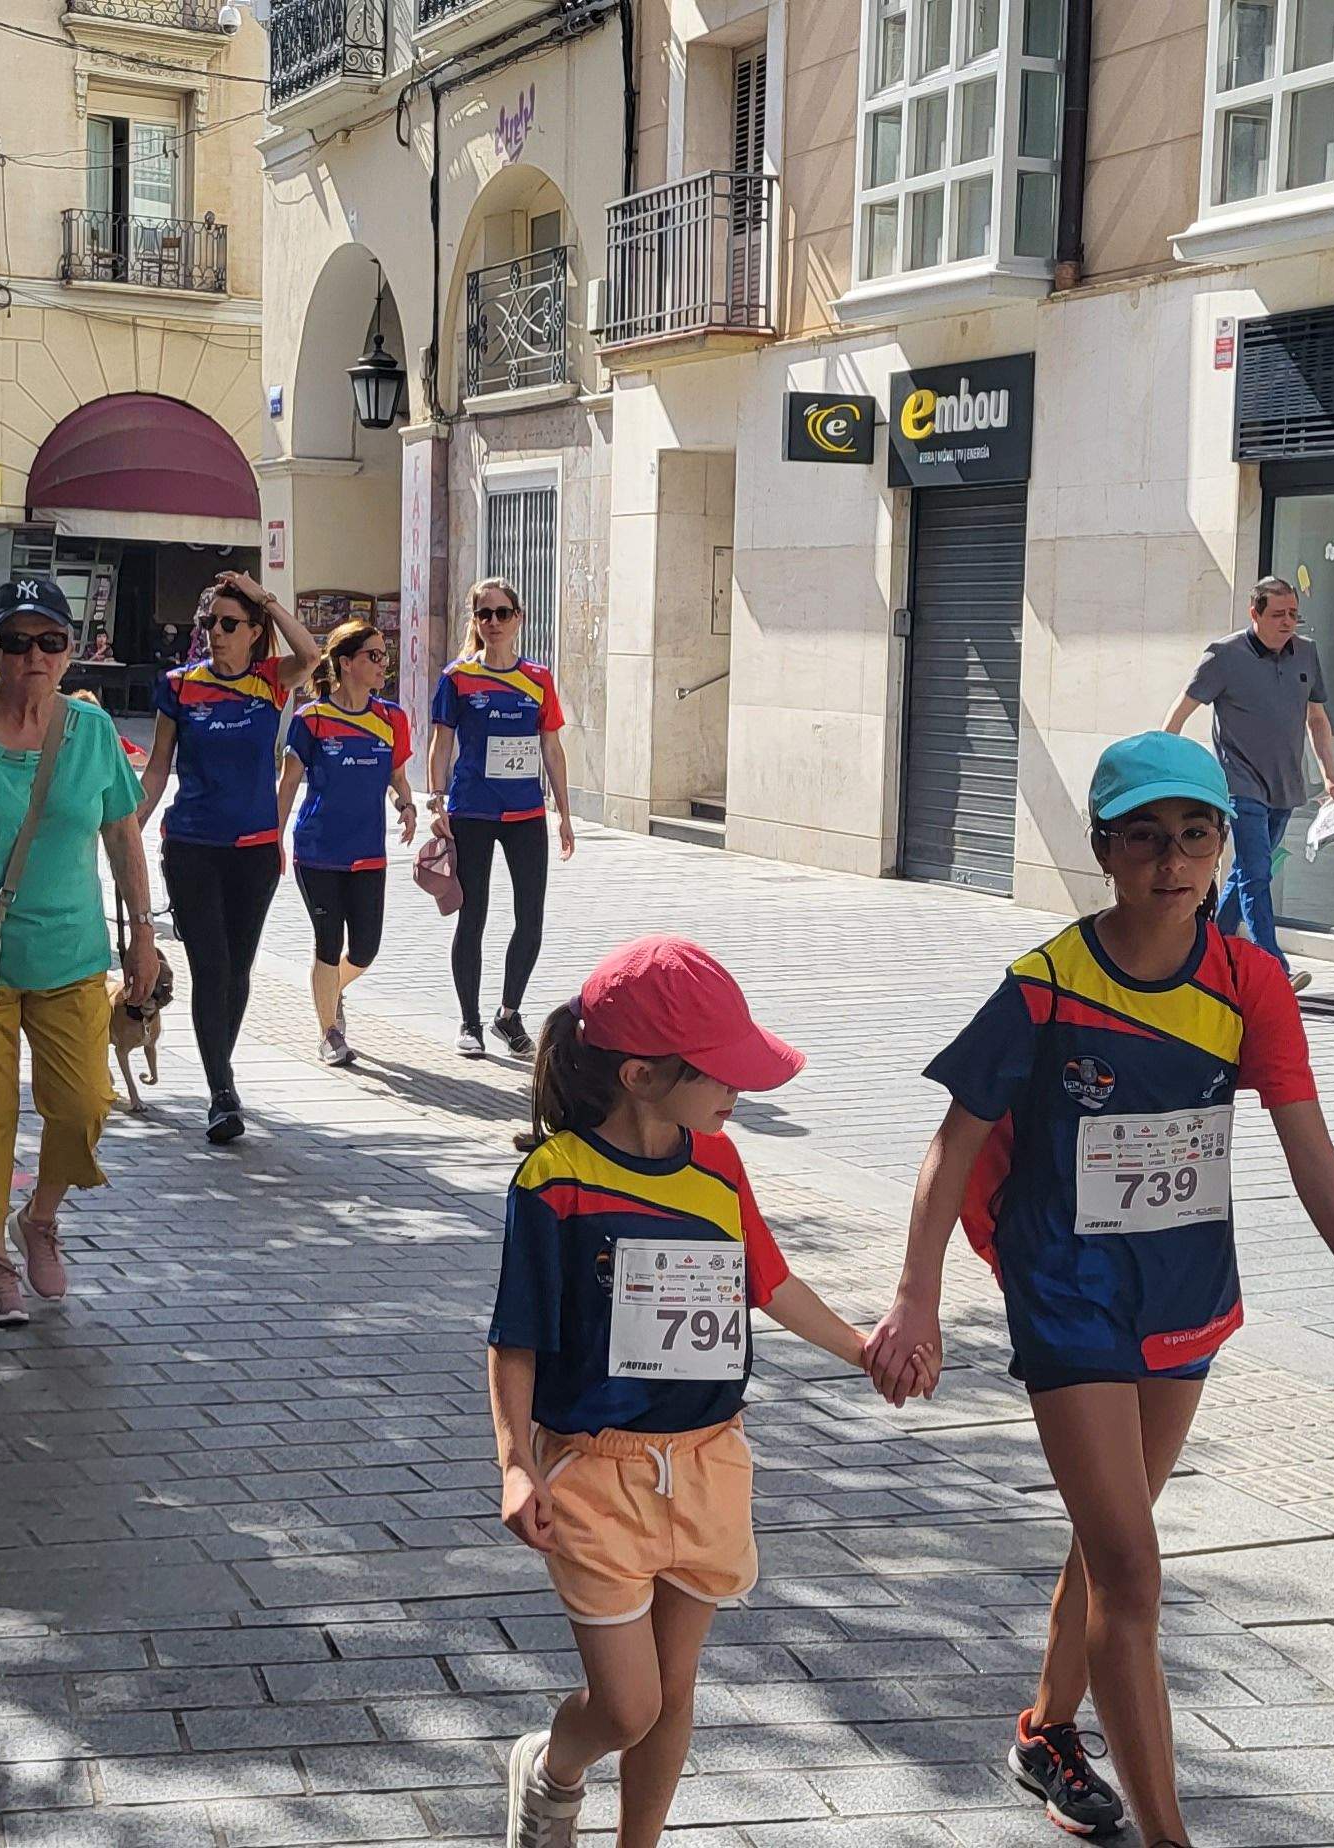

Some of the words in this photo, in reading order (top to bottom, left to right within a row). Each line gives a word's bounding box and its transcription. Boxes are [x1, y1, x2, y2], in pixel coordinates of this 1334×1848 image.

[900, 377, 1010, 440] embou
[967, 442, 990, 460] ENERGÍA
[409, 456, 422, 731] FARMACIA
[504, 757, 525, 770] 42
[1114, 1166, 1198, 1210] 739
[655, 1309, 742, 1351] 794
